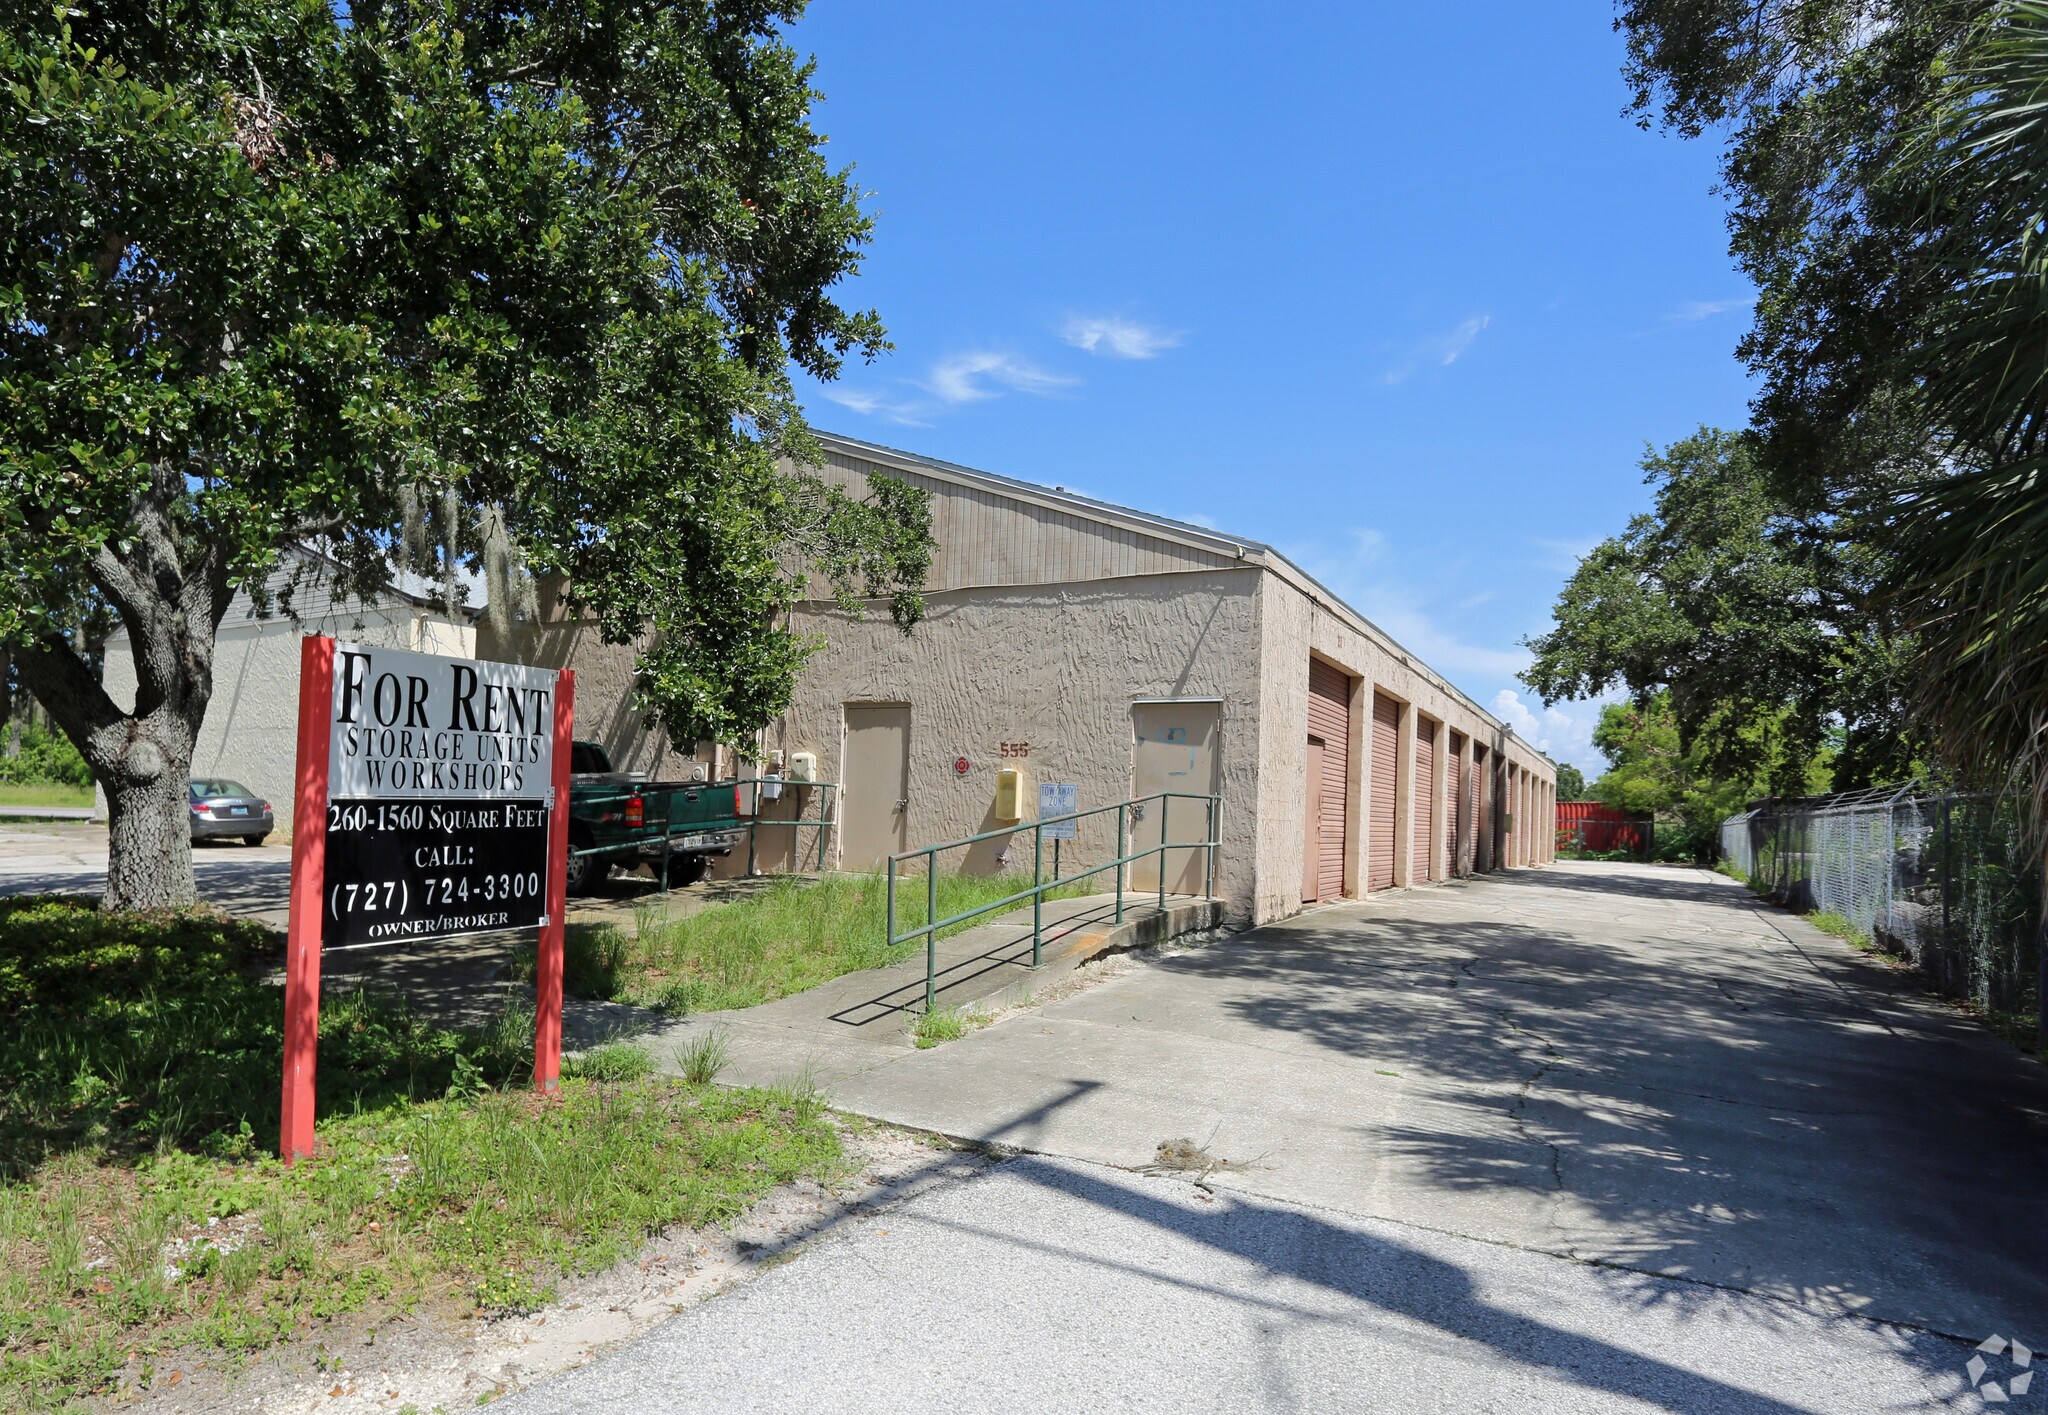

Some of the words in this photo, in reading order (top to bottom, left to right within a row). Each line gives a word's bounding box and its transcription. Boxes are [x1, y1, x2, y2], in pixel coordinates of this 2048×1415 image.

[336, 651, 429, 729] FOR
[447, 664, 549, 737] RENT
[346, 726, 464, 761] STORAGE
[477, 735, 540, 764] UNITS
[1000, 741, 1028, 757] 555
[366, 760, 524, 791] WORKSHOPS
[1041, 785, 1055, 797] TOW
[1057, 785, 1075, 797] AWAY
[1048, 796, 1066, 807] ZONE
[328, 804, 423, 832] 260-1560
[428, 804, 499, 834] SQUARE
[503, 804, 545, 828] FEET
[415, 845, 474, 868] CALL:
[331, 879, 409, 921] (727)
[425, 872, 539, 905] 724-3300
[368, 911, 509, 938] OWNER/BROKER
